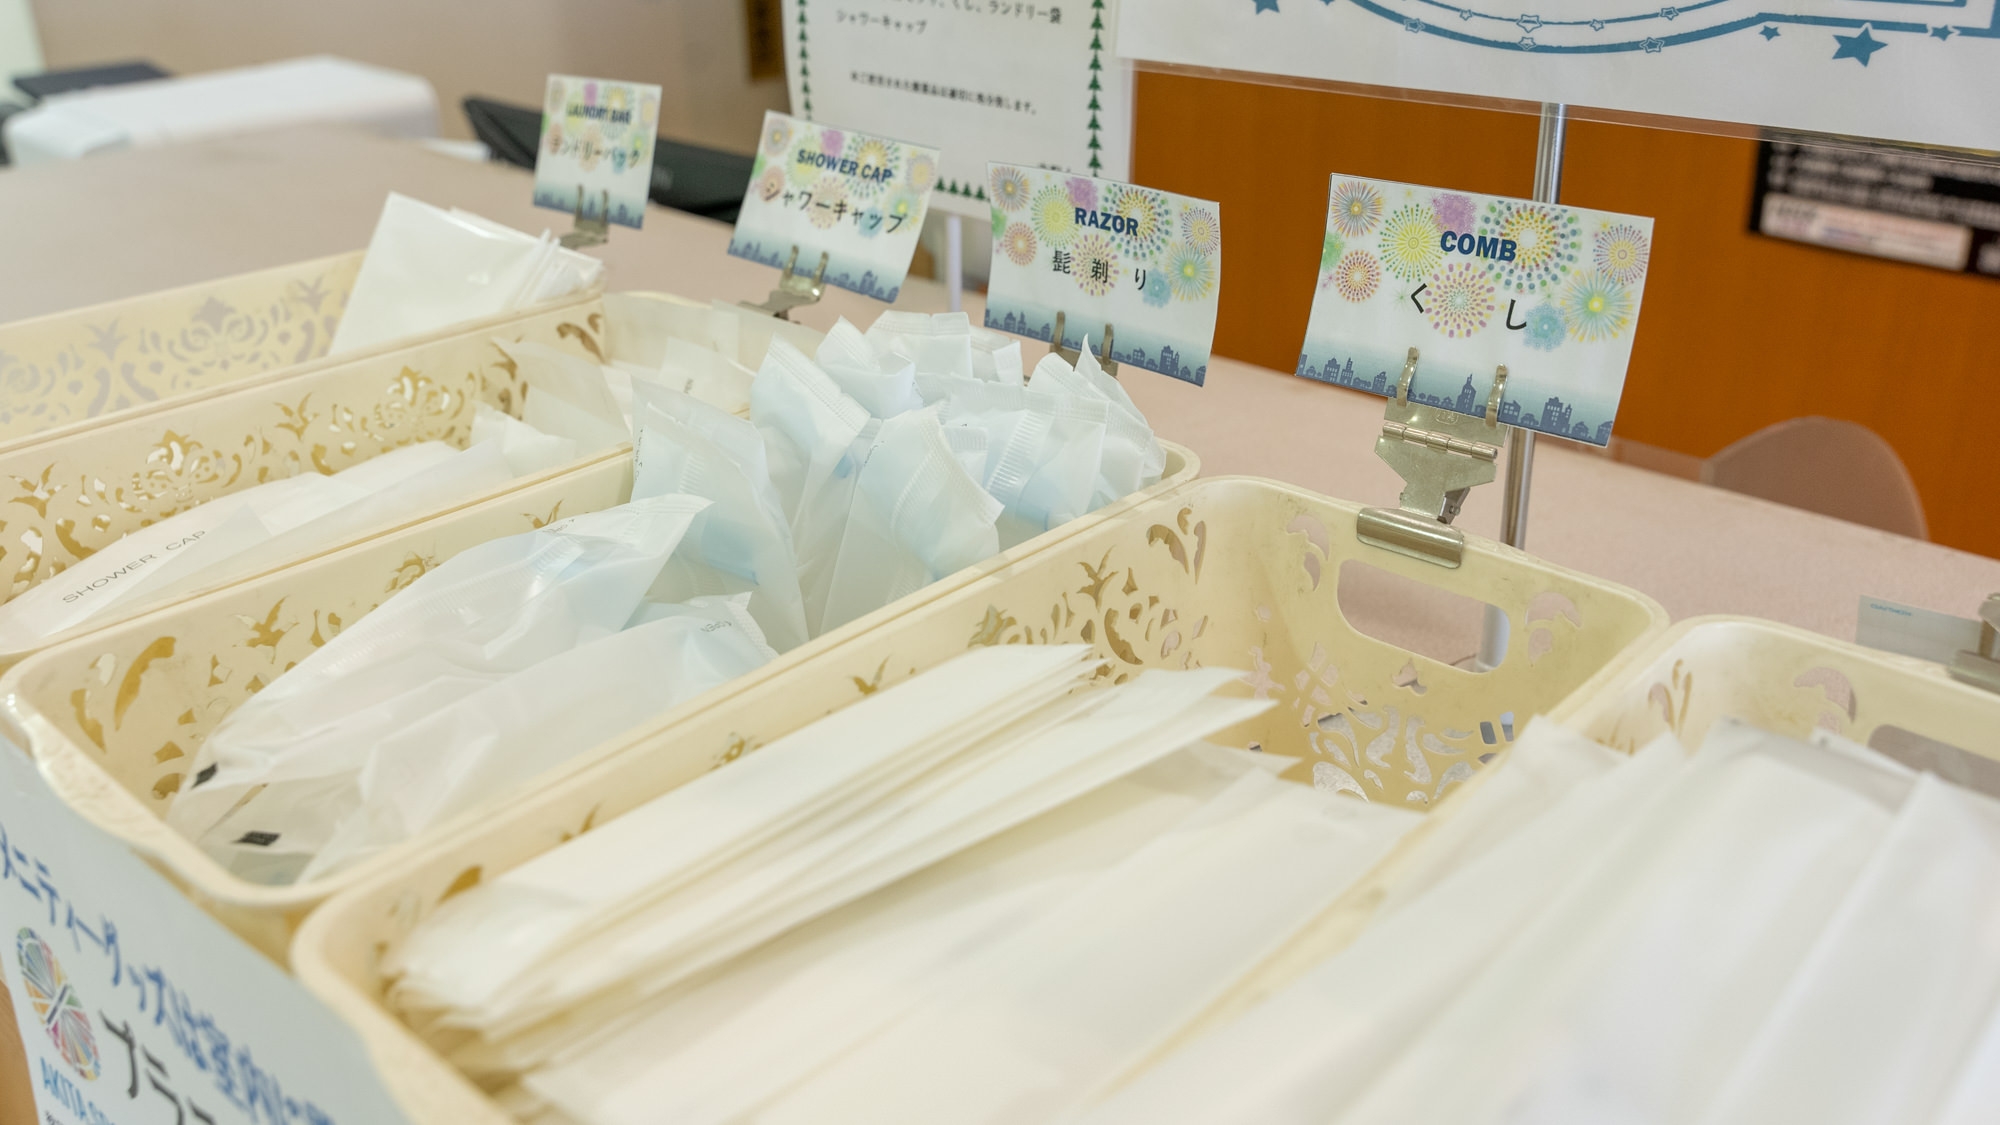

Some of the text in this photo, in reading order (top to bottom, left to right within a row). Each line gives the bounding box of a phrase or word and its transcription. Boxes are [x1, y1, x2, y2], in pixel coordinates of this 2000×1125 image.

[797, 149, 893, 183] SHOWER CAP
[764, 182, 908, 234] シャワーキャップ
[1074, 206, 1139, 237] RAZOR
[1440, 230, 1517, 262] COMB
[62, 529, 206, 604] SHOWER CAP
